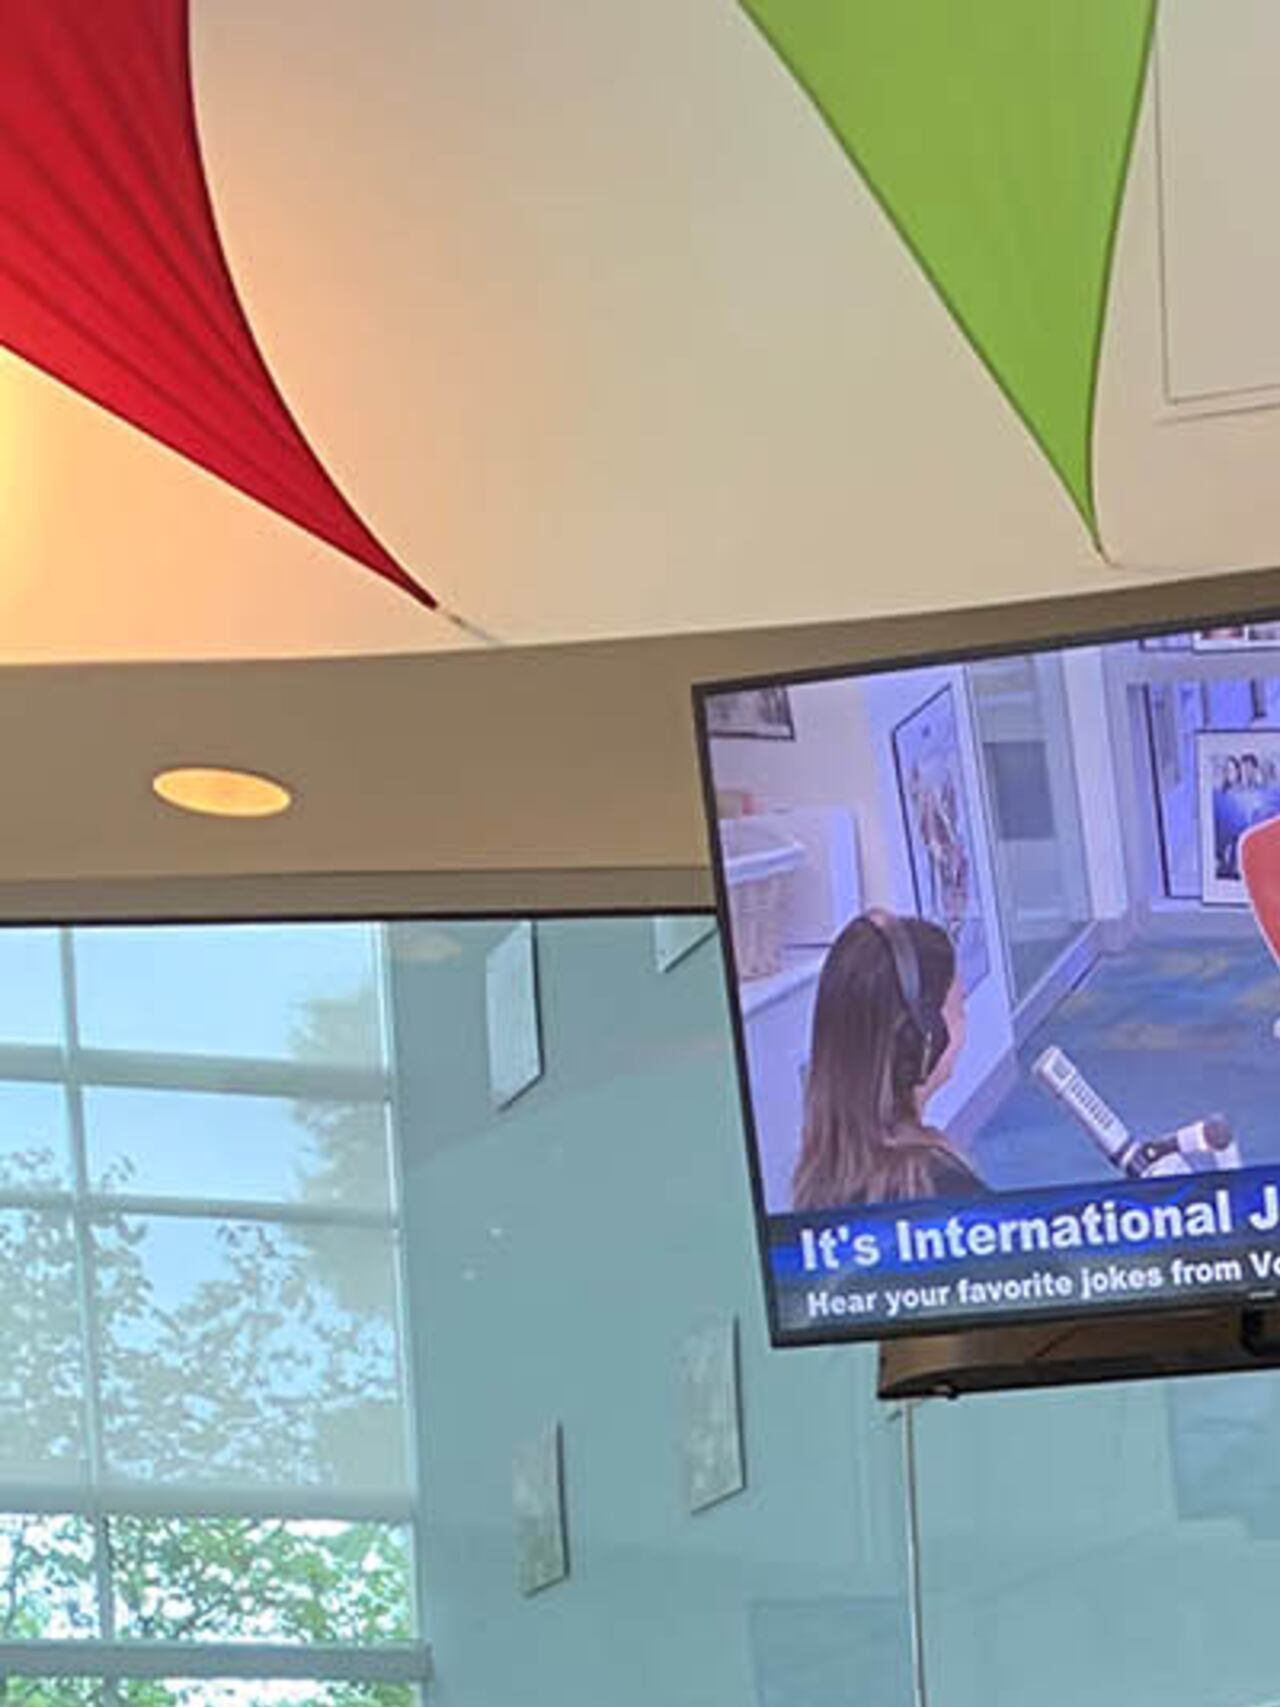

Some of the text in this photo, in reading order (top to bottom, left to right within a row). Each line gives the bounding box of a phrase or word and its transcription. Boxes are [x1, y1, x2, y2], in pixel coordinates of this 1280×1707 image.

[801, 1225, 882, 1271] It's
[896, 1188, 1234, 1262] International
[807, 1291, 878, 1318] Hear
[884, 1284, 951, 1316] your
[956, 1271, 1074, 1304] favorite
[1080, 1265, 1163, 1300] jokes
[1170, 1256, 1243, 1286] from
